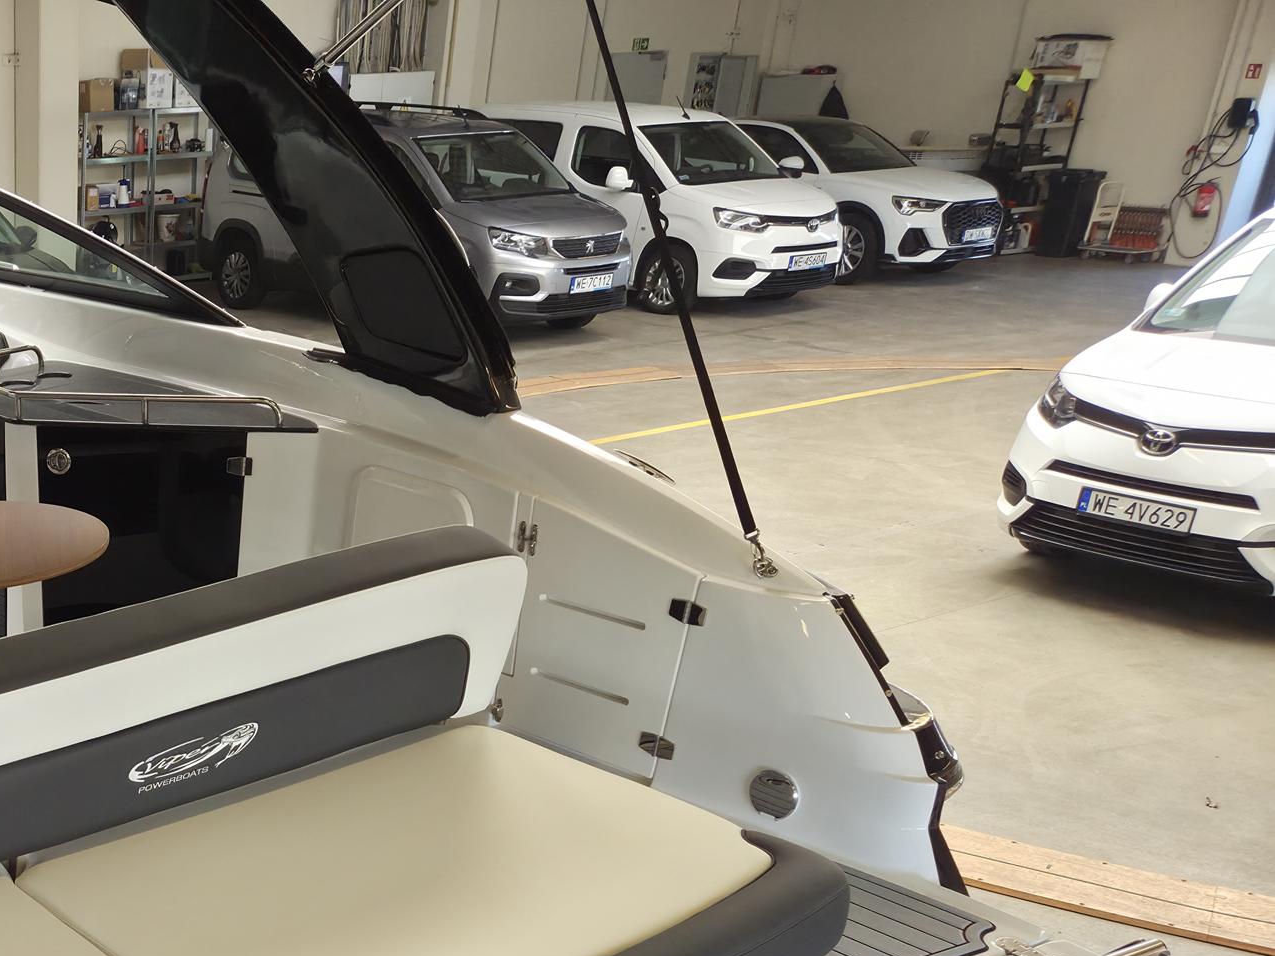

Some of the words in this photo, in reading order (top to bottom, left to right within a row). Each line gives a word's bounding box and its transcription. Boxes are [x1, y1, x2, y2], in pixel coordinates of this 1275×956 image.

[576, 277, 586, 290] WE
[588, 274, 612, 289] 7C112
[1092, 493, 1119, 517] WE
[1123, 502, 1188, 530] 4V629
[144, 742, 221, 774] Viper
[137, 765, 210, 794] POWERBOATS
